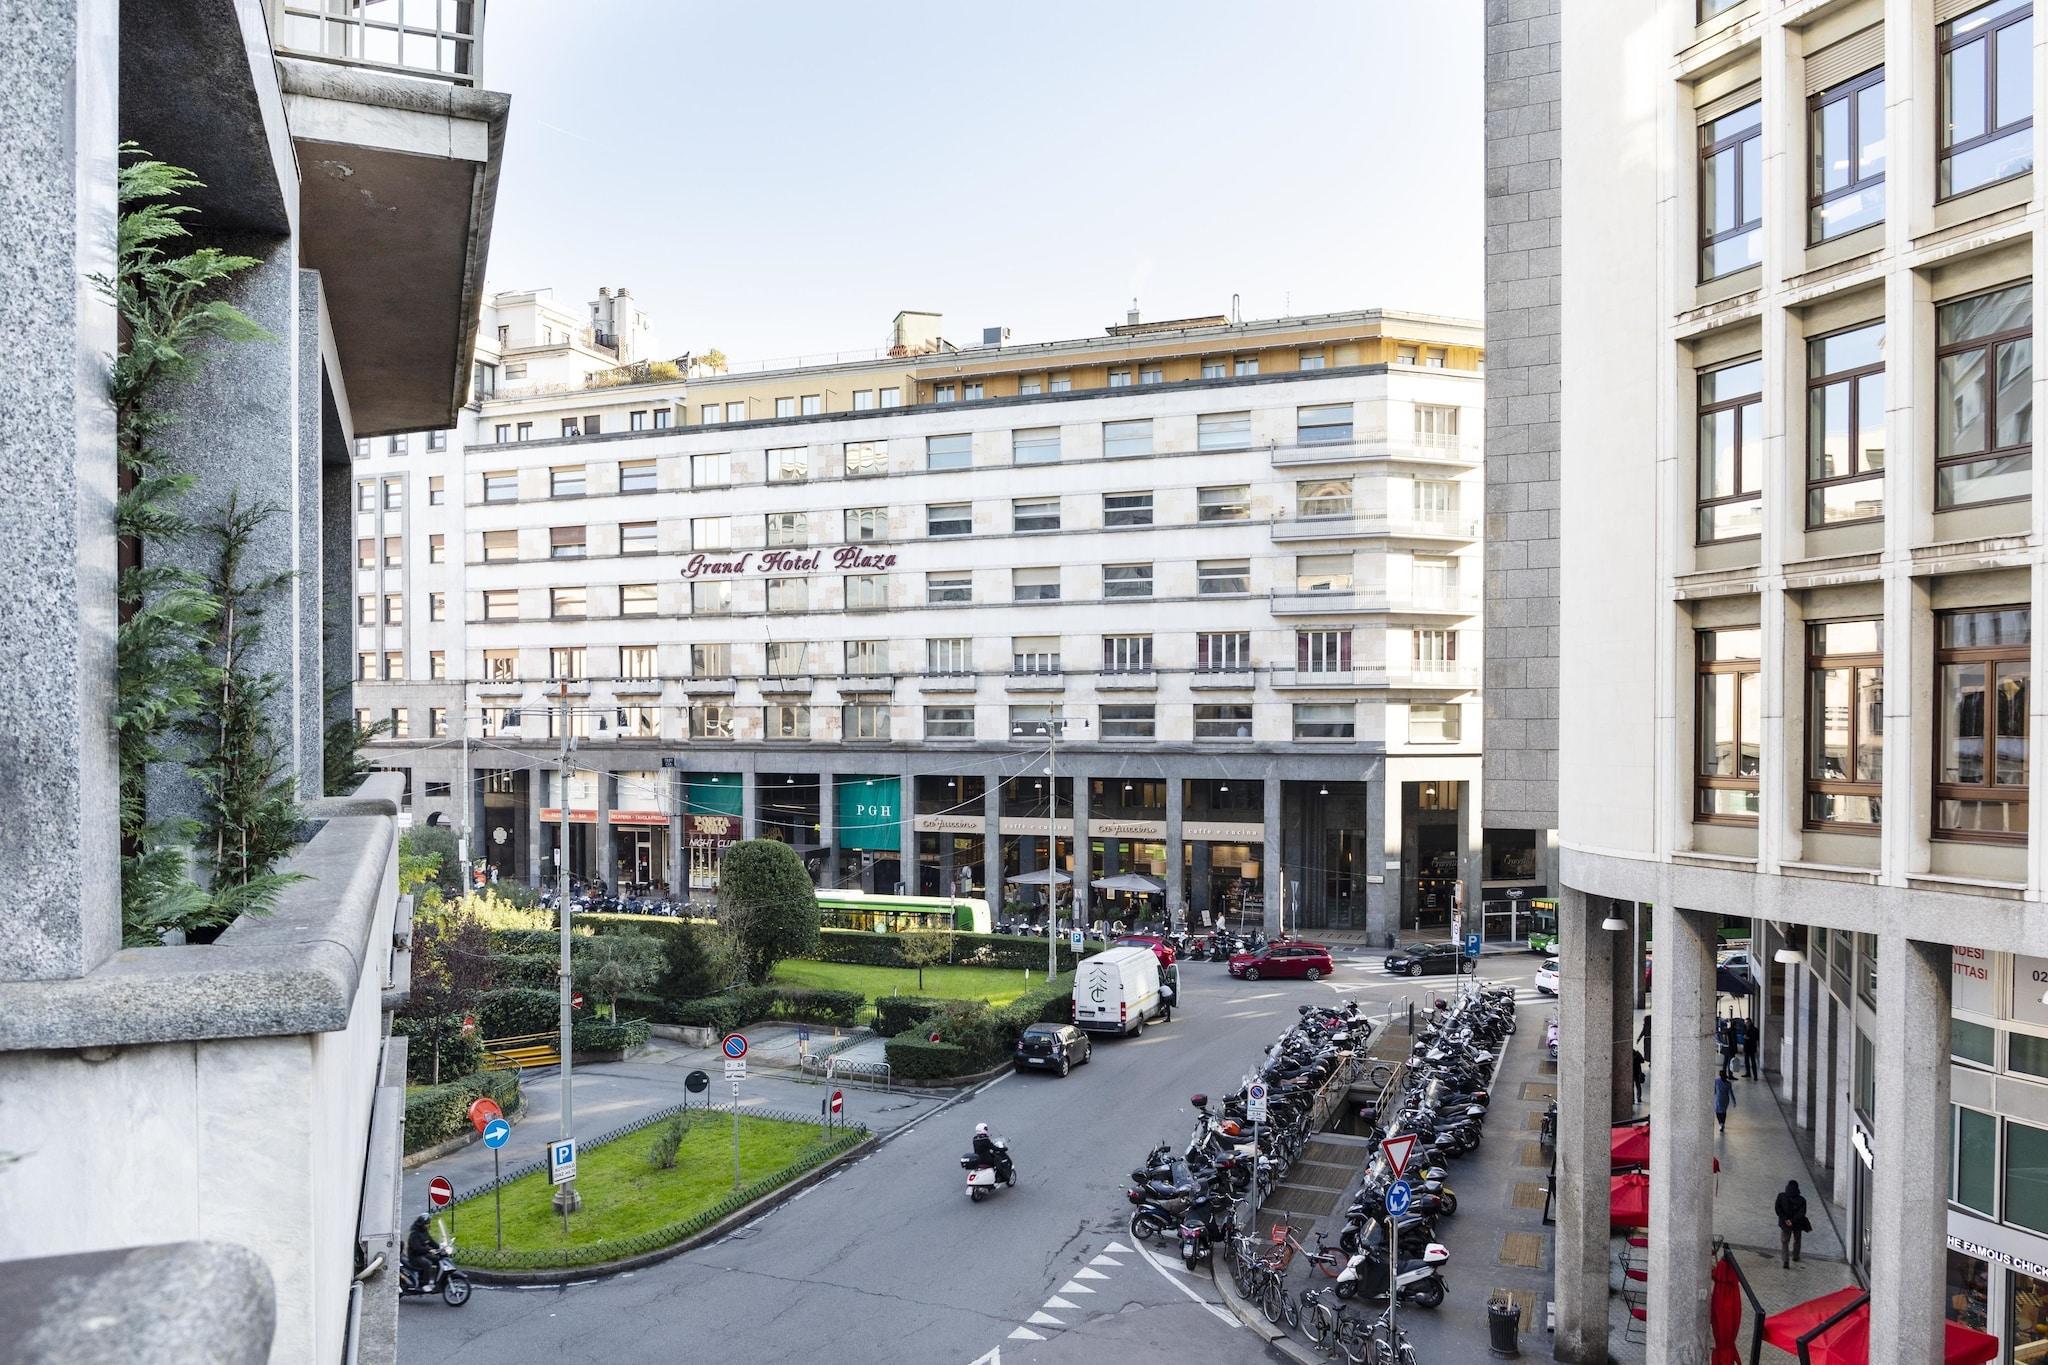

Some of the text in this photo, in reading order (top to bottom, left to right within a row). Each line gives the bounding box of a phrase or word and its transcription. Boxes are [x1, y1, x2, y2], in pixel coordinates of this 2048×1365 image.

[681, 546, 896, 578] Grand Hotel Plaza
[689, 838, 715, 848] NIGHT
[559, 1147, 569, 1163] P
[1964, 1242, 2011, 1264] FAMOUS
